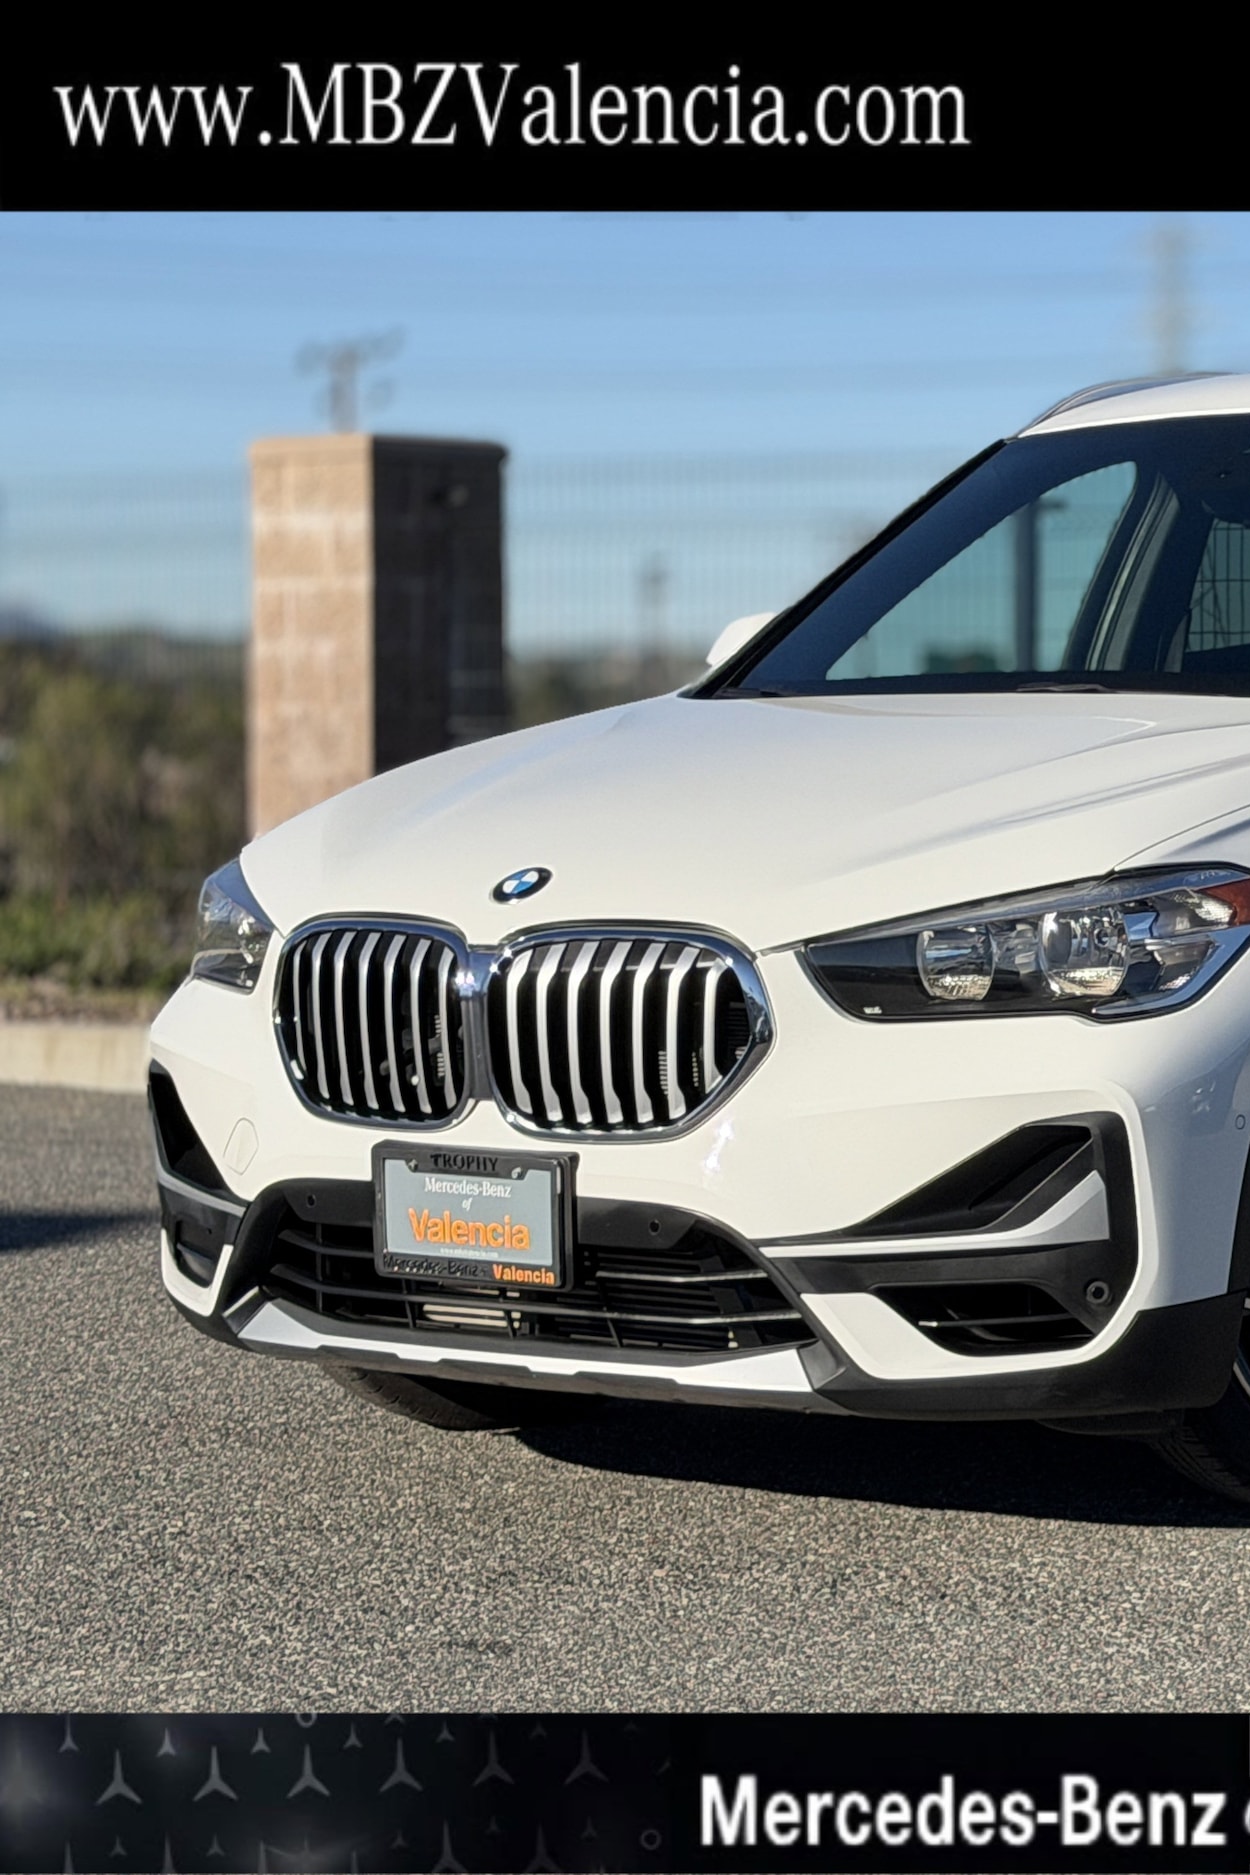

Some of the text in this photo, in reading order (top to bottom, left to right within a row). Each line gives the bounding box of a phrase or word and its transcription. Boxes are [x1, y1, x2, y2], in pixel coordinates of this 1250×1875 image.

[430, 1153, 498, 1172] TROPHY
[424, 1176, 512, 1198] Mercedes-Benz
[462, 1197, 473, 1211] of
[408, 1207, 531, 1250] Valencia
[492, 1263, 556, 1286] Valencia
